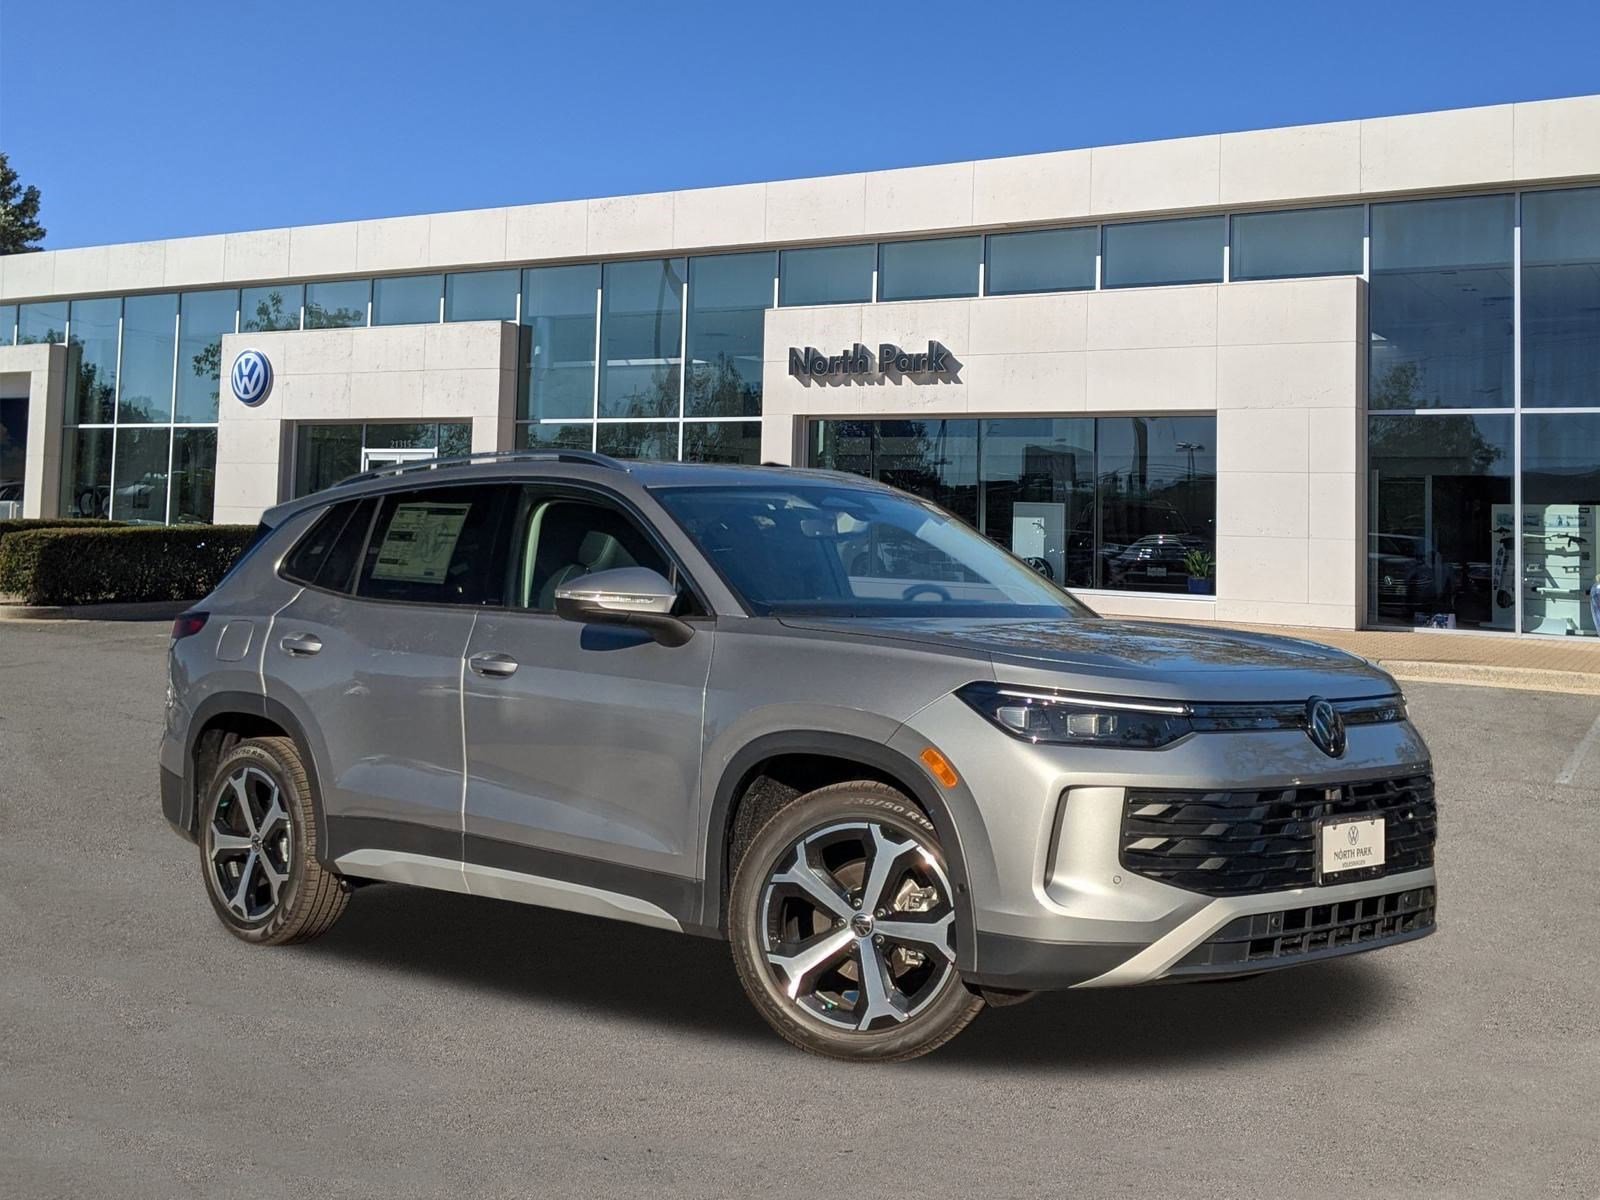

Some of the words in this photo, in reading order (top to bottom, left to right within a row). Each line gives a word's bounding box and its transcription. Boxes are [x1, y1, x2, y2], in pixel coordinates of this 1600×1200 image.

[788, 341, 871, 376] North
[878, 340, 949, 373] Park
[233, 353, 267, 400] VW
[906, 811, 935, 830] R19
[1334, 848, 1355, 860] NORTH
[1356, 847, 1373, 857] PARK
